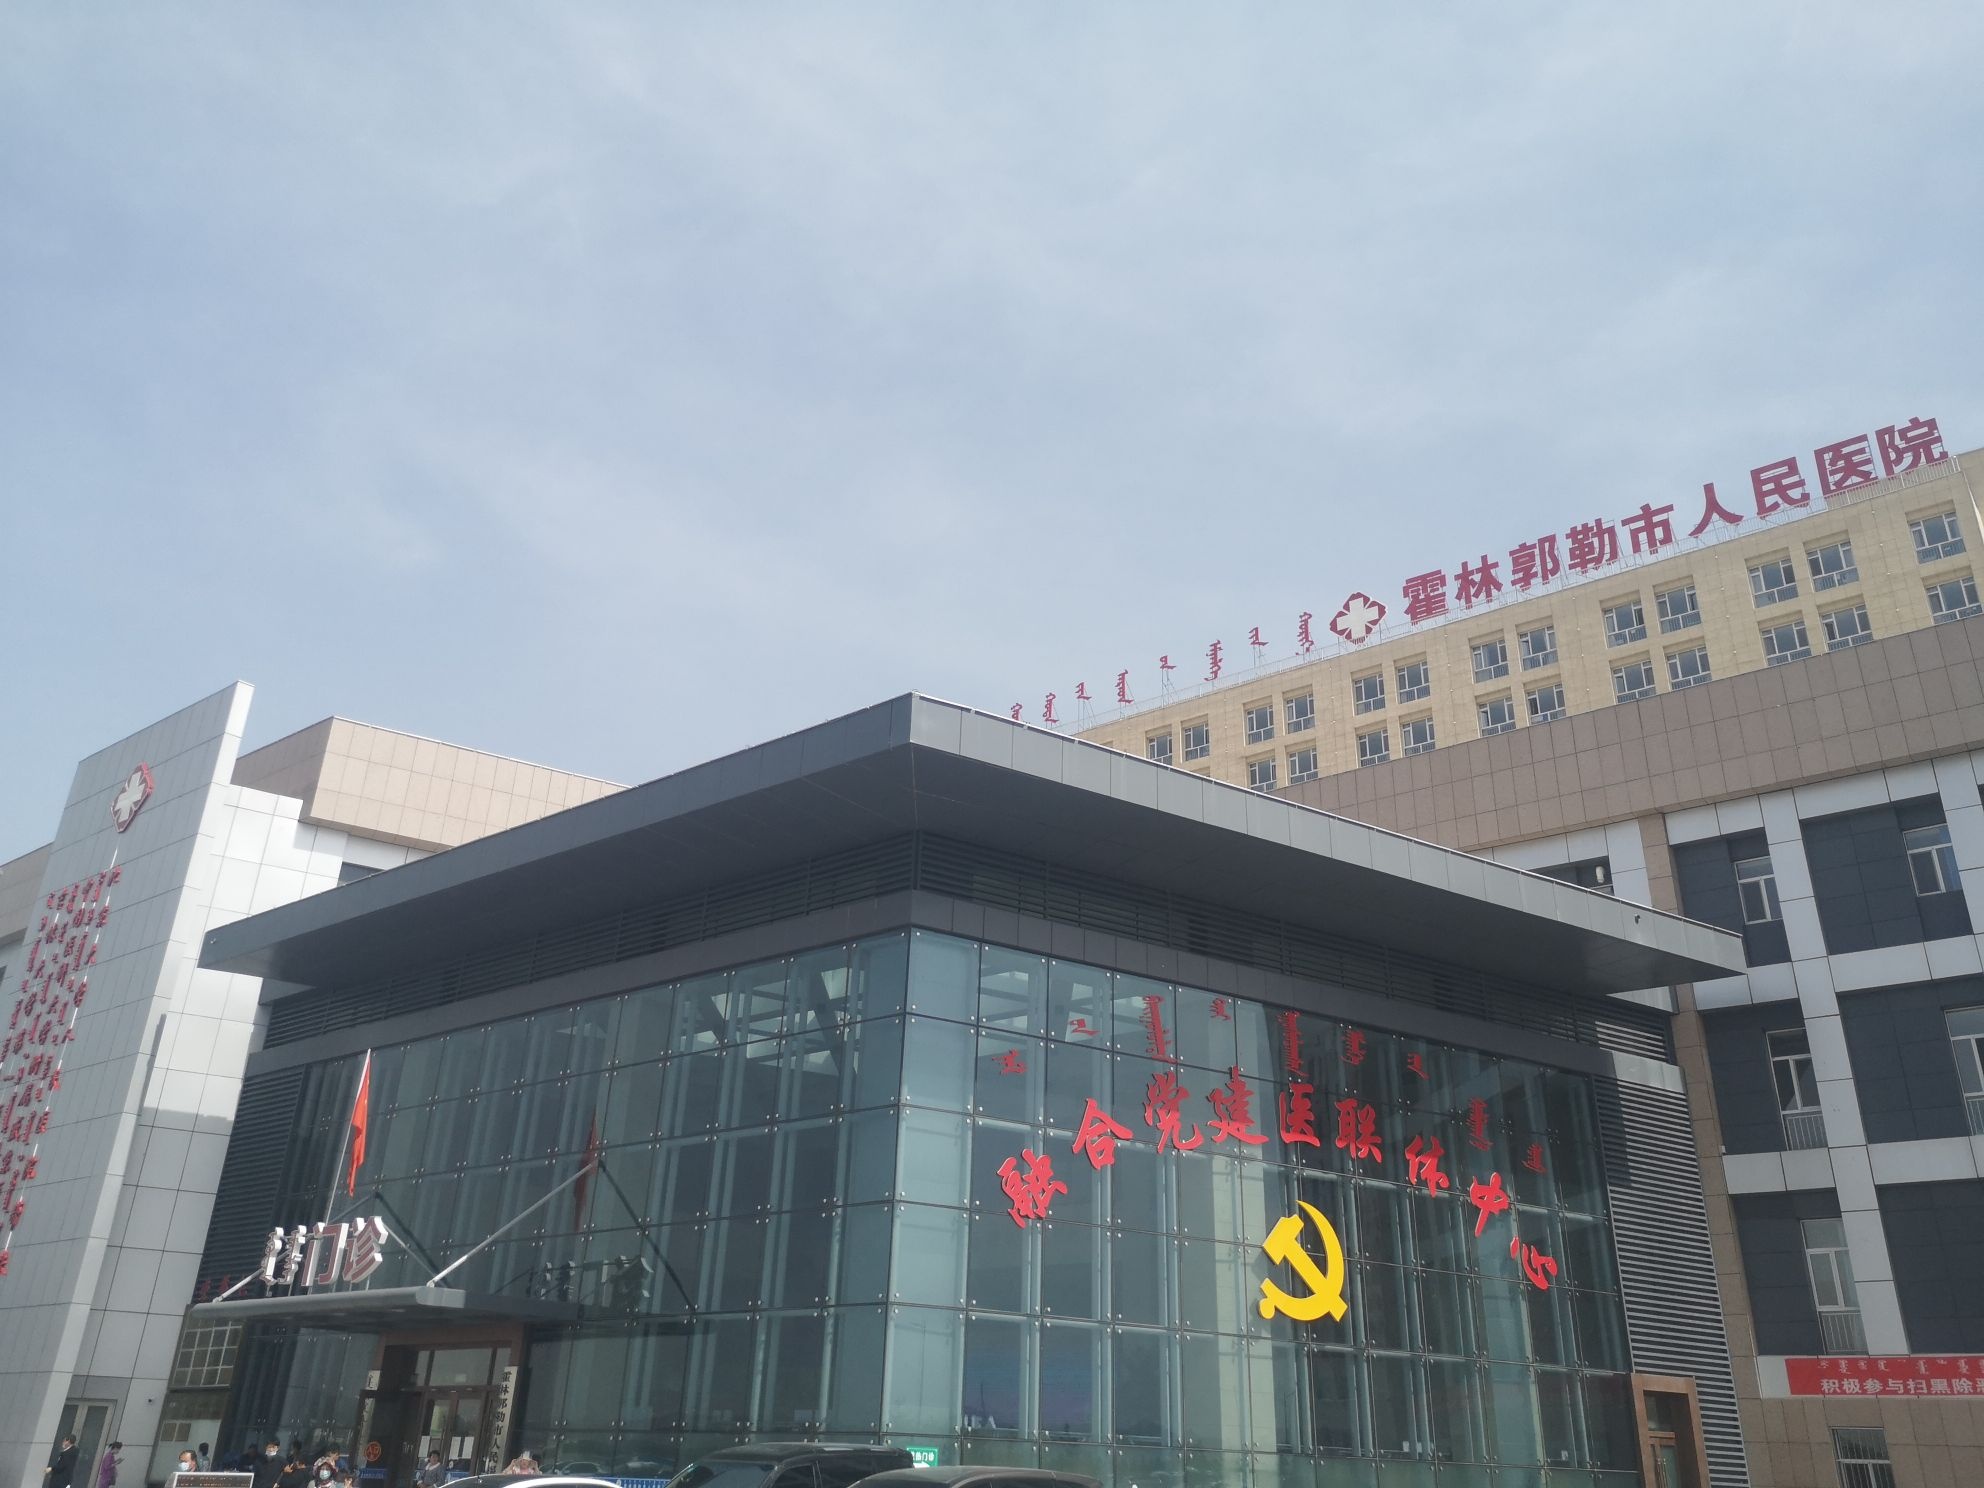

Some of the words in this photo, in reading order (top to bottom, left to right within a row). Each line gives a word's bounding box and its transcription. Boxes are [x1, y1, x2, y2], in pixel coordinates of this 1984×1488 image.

[1402, 417, 1949, 625] 霍林郭勒市人民医院
[301, 1215, 389, 1287] 门诊
[995, 1066, 1558, 1290] 融合党建医联体中心
